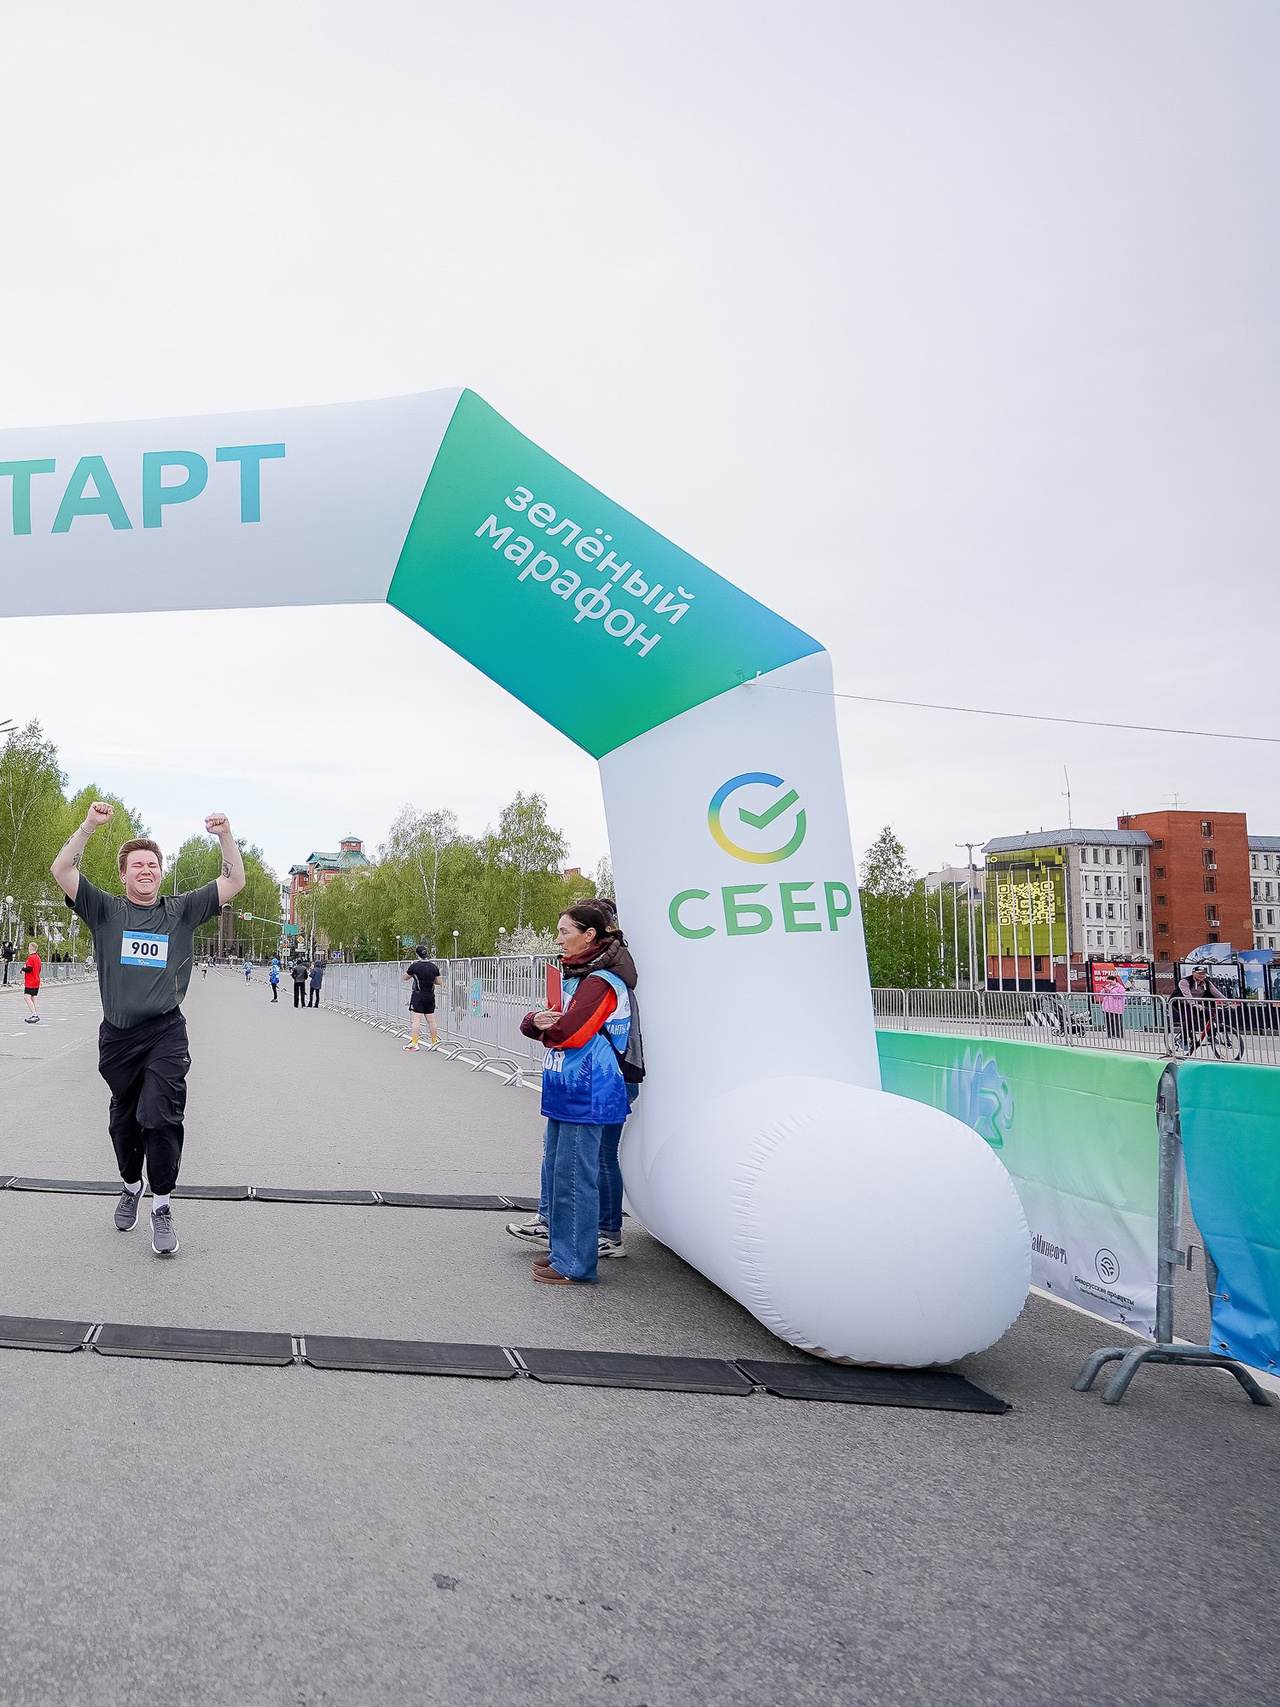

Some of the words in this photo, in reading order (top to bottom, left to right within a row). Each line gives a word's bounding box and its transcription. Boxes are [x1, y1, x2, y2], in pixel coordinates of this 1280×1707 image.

[504, 485, 696, 625] зелёный
[474, 513, 662, 658] марафон
[668, 881, 852, 940] СБЕР
[131, 941, 159, 957] 900
[1074, 1275, 1107, 1294] Белорусские
[1106, 1290, 1135, 1306] продукты
